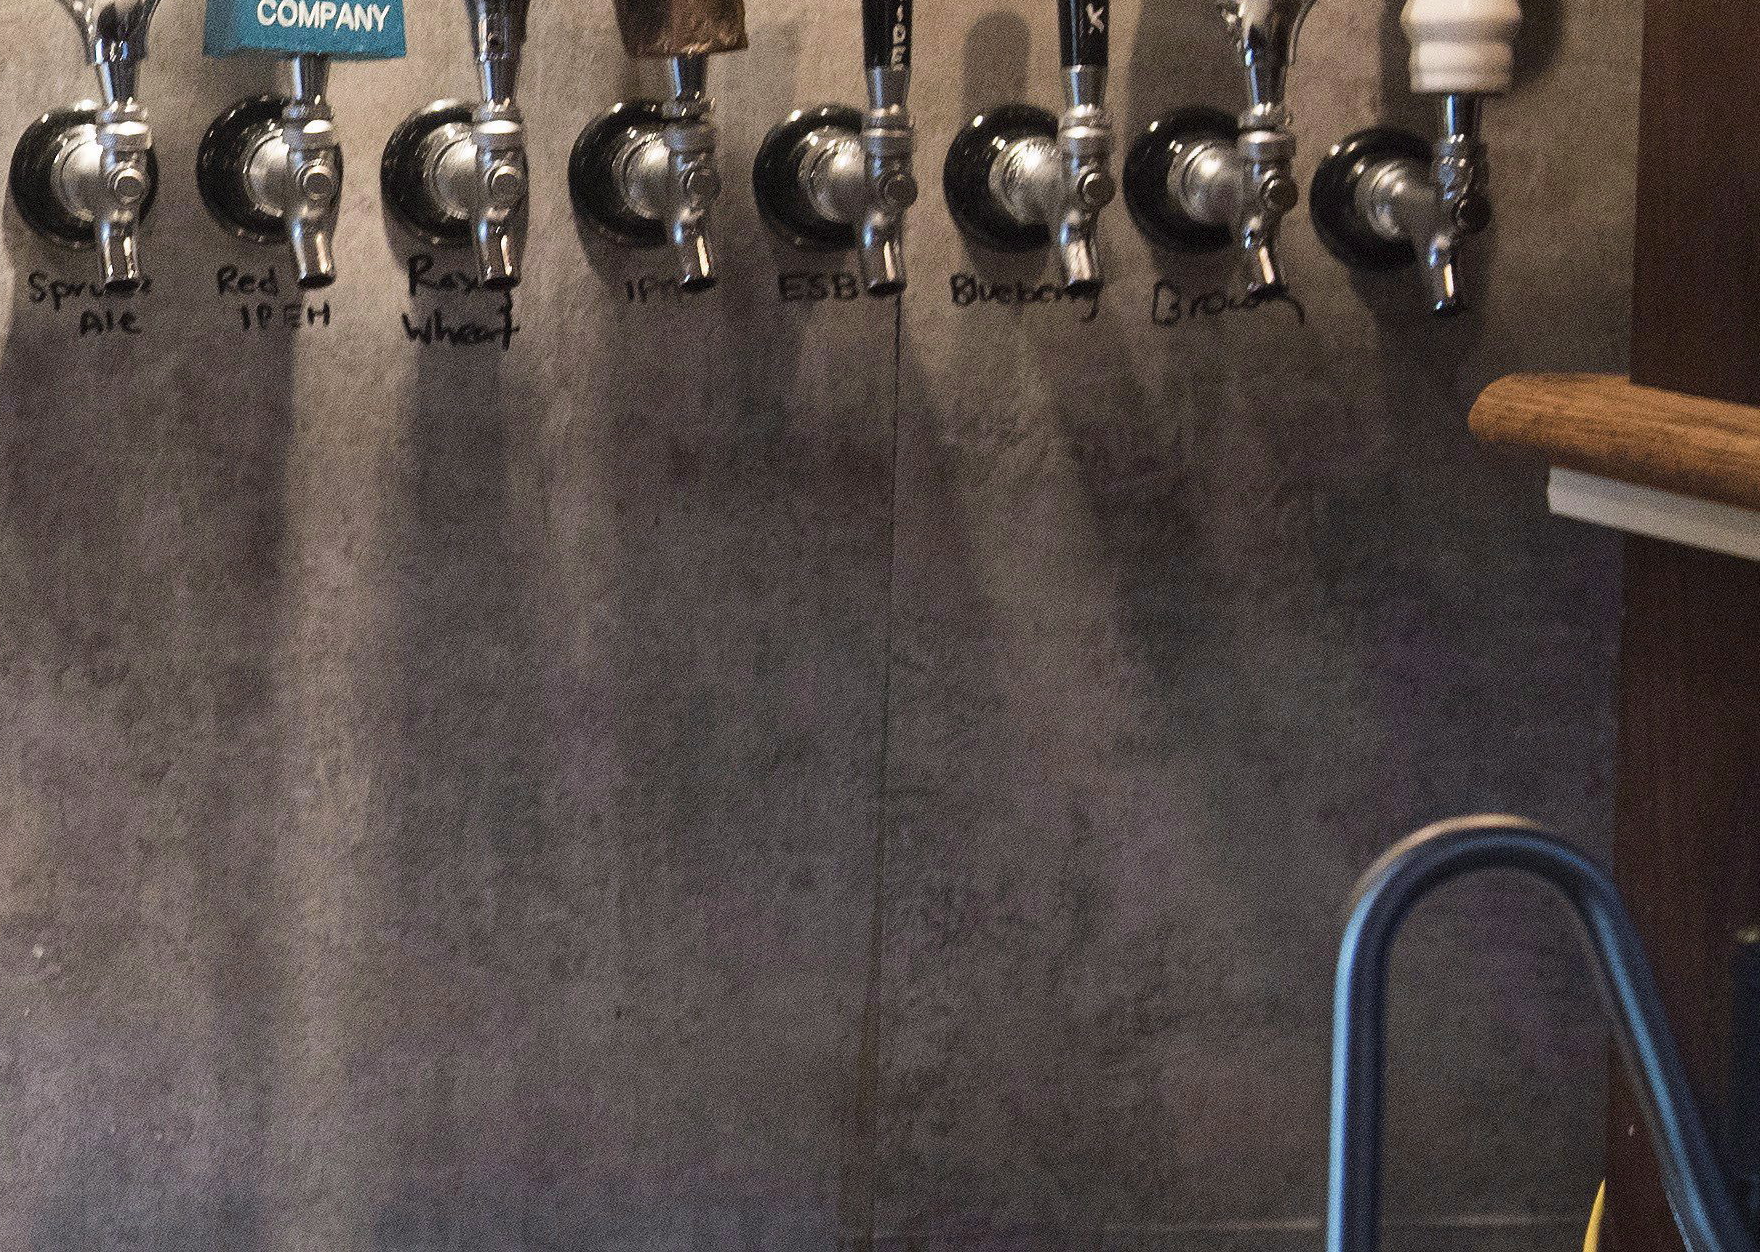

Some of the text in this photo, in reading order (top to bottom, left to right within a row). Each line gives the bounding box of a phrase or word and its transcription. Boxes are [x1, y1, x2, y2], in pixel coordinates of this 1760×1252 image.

[216, 265, 279, 297] Red
[781, 272, 859, 301] ESB
[80, 309, 142, 336] Ale
